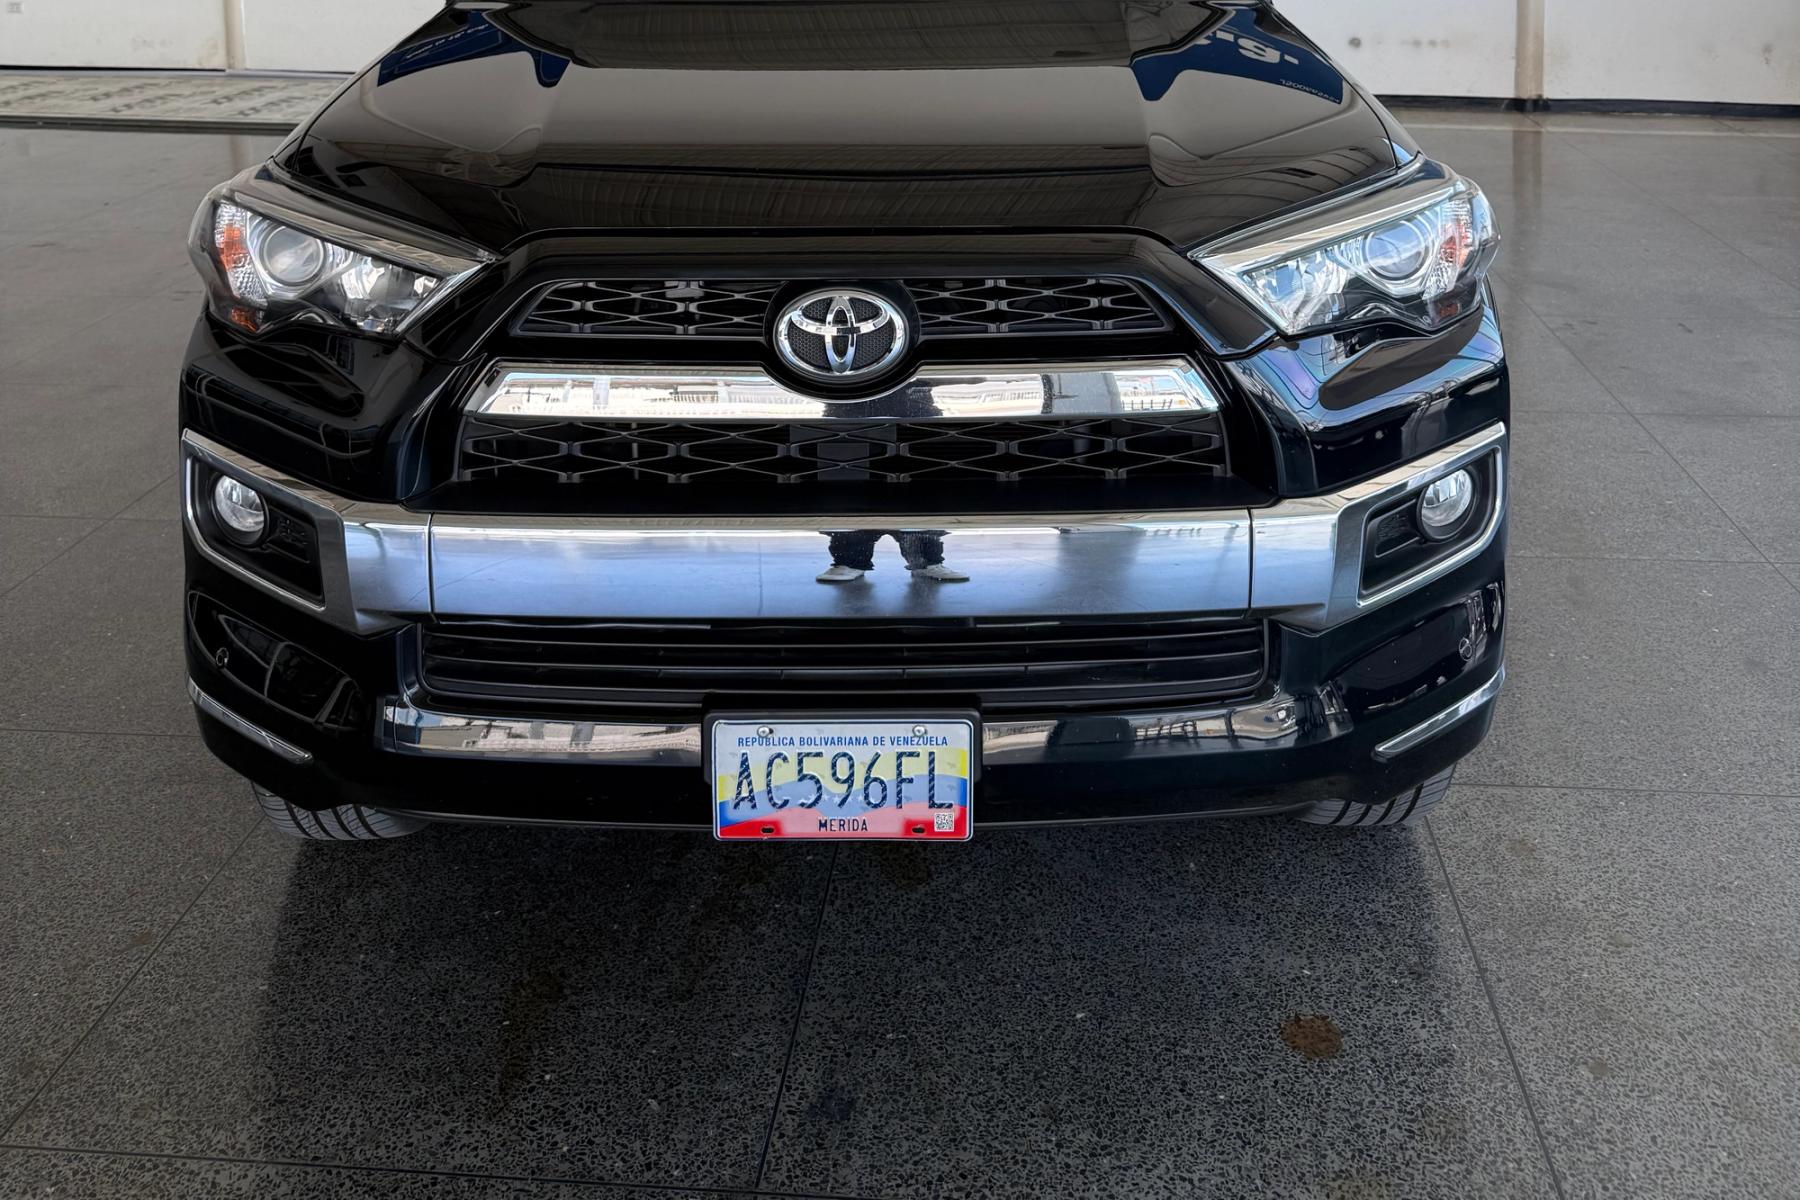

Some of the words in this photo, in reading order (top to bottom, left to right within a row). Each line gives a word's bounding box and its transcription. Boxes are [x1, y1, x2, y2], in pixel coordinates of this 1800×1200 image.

[799, 736, 869, 747] BOLIVARIANA
[872, 736, 886, 746] DE
[889, 735, 948, 747] VENEZUELA
[733, 751, 954, 810] AC596FL
[818, 818, 868, 832] MERIDA
